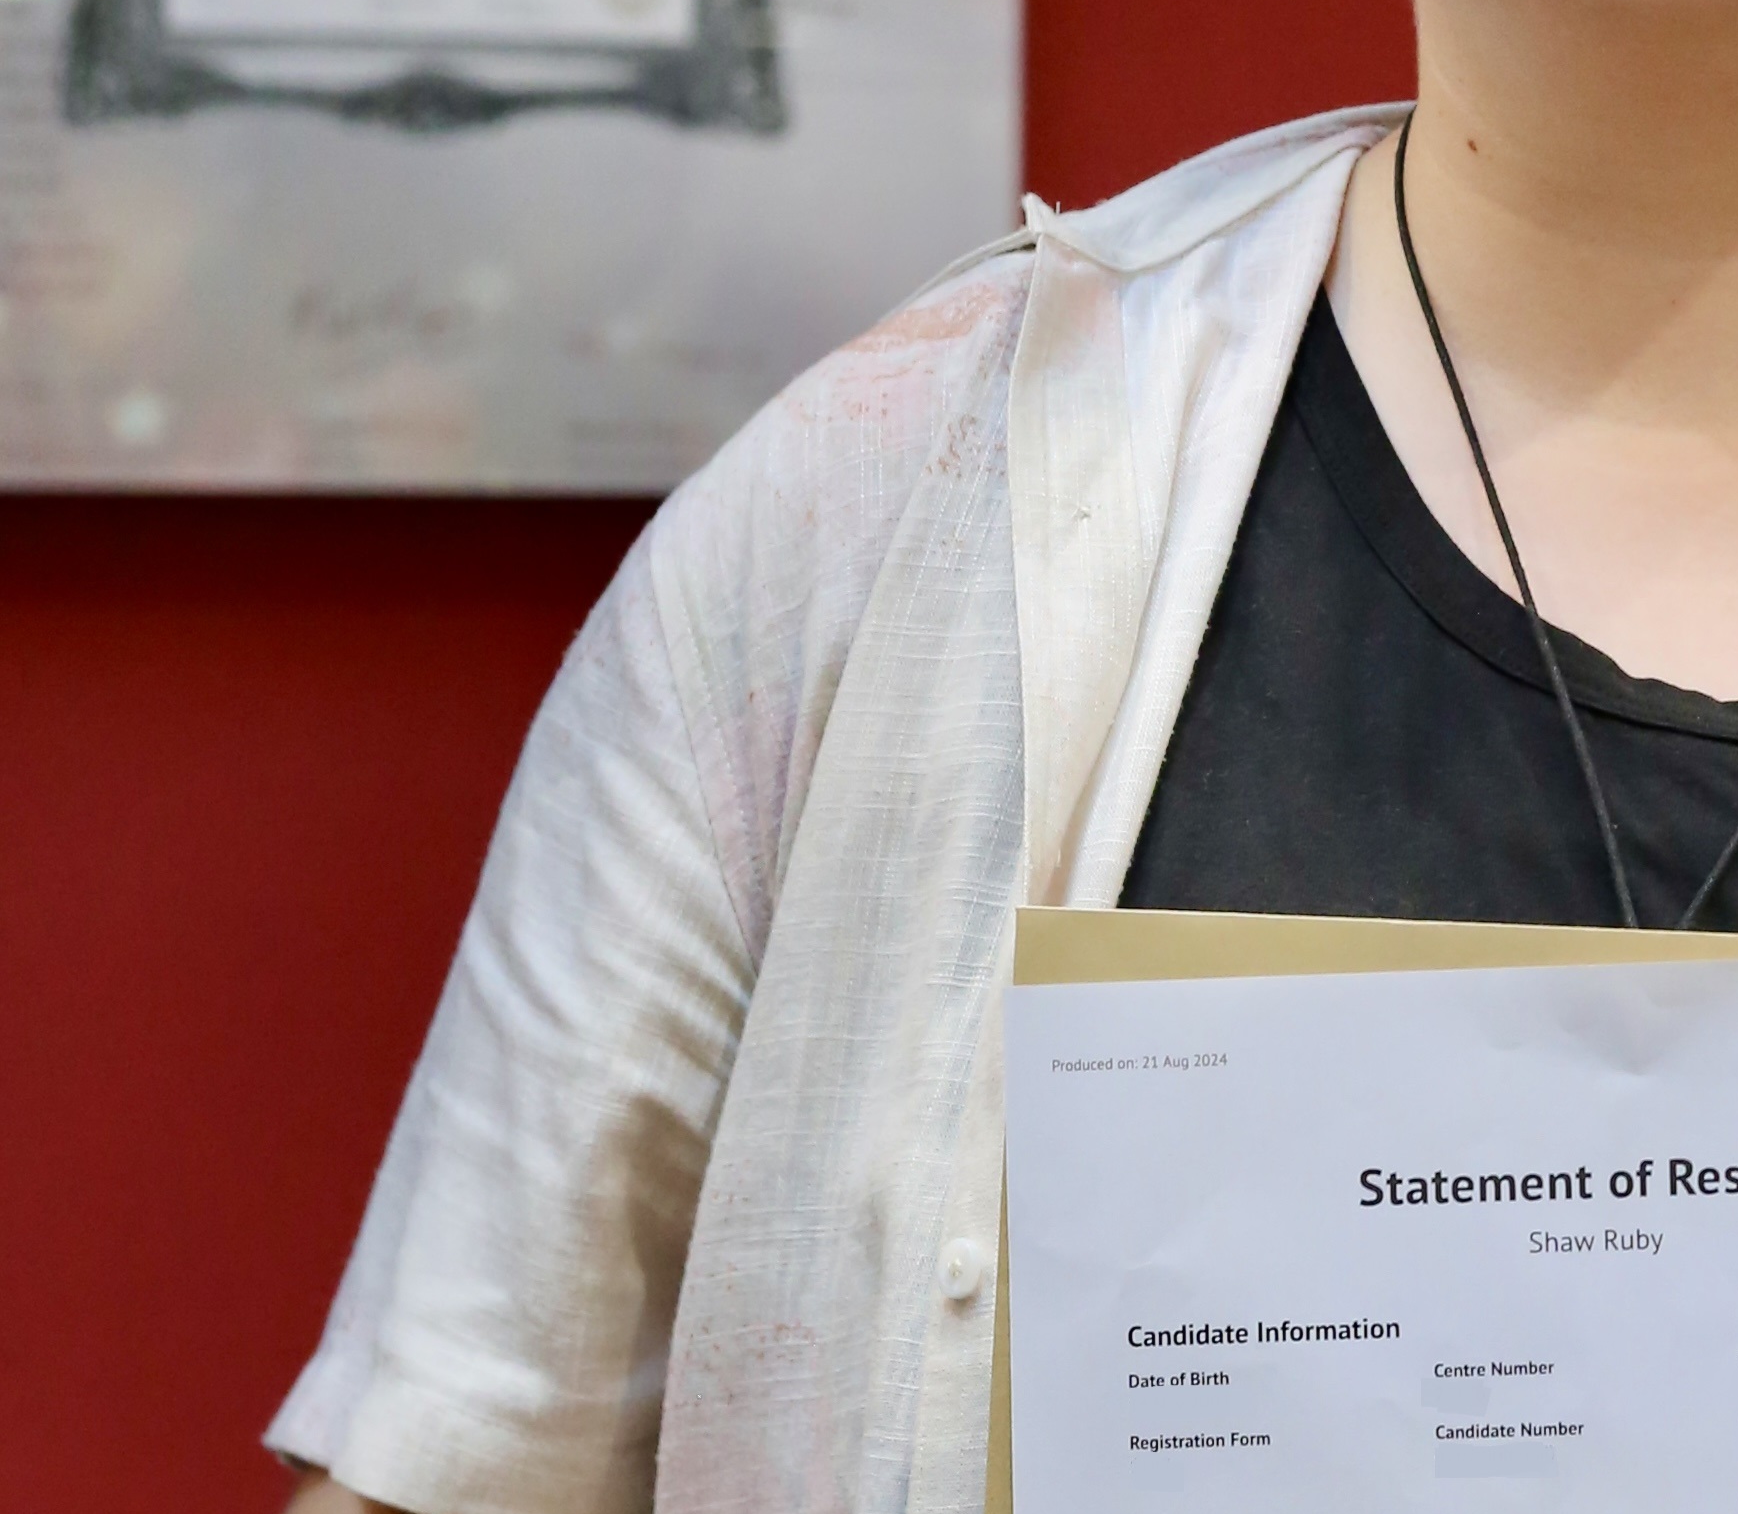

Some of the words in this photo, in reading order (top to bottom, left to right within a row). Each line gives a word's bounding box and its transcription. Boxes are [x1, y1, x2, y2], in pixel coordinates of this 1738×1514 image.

[1052, 1058, 1113, 1072] Produced
[1118, 1060, 1139, 1069] on:
[1143, 1056, 1158, 1069] 21
[1163, 1056, 1189, 1070] Aug
[1194, 1053, 1227, 1067] 2024
[1359, 1165, 1593, 1207] Statement
[1609, 1159, 1654, 1199] of
[1530, 1231, 1595, 1253] Shaw
[1605, 1228, 1663, 1255] Ruby
[1128, 1323, 1248, 1348] Candidate
[1258, 1318, 1400, 1343] Information
[1434, 1363, 1486, 1378] Centre
[1491, 1360, 1554, 1376] Number
[1129, 1374, 1165, 1388] Date
[1170, 1372, 1186, 1386] of
[1190, 1371, 1229, 1386] Birth
[1436, 1424, 1515, 1440] Candidate
[1521, 1421, 1584, 1437] Number
[1130, 1433, 1225, 1452] Registration
[1231, 1432, 1270, 1447] Form
